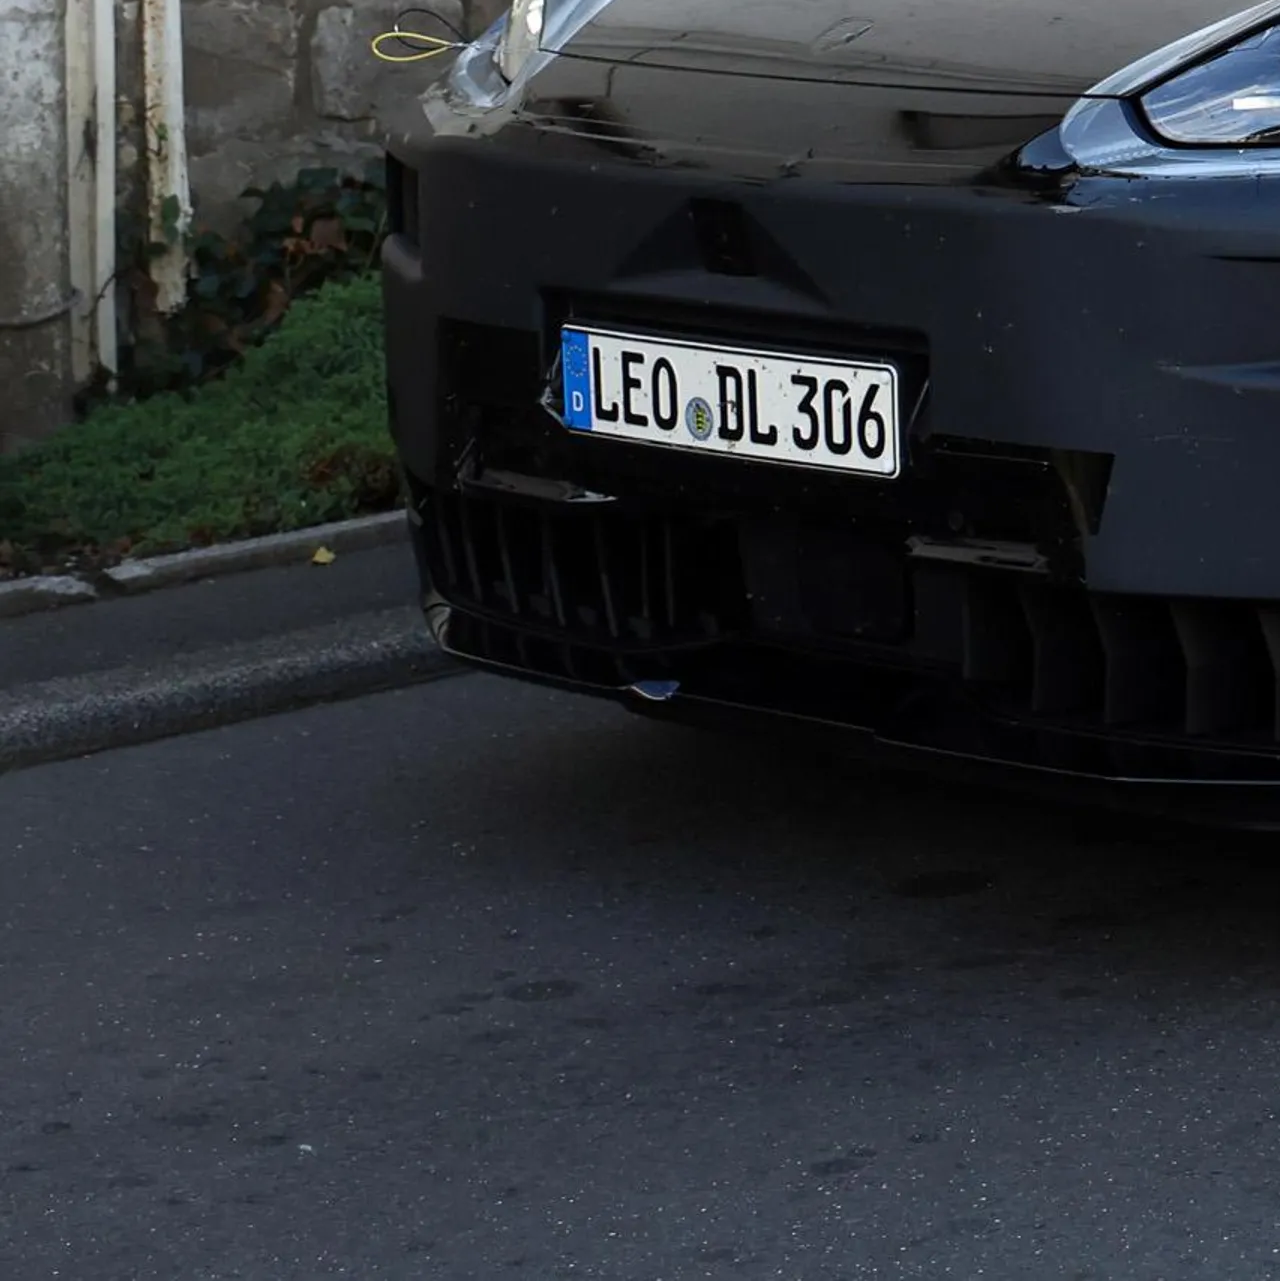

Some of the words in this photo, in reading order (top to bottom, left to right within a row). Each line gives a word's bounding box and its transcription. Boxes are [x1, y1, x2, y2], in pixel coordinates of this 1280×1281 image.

[572, 390, 584, 412] D
[592, 346, 678, 431] LEO
[716, 365, 778, 446] DL
[790, 374, 886, 459] 306
